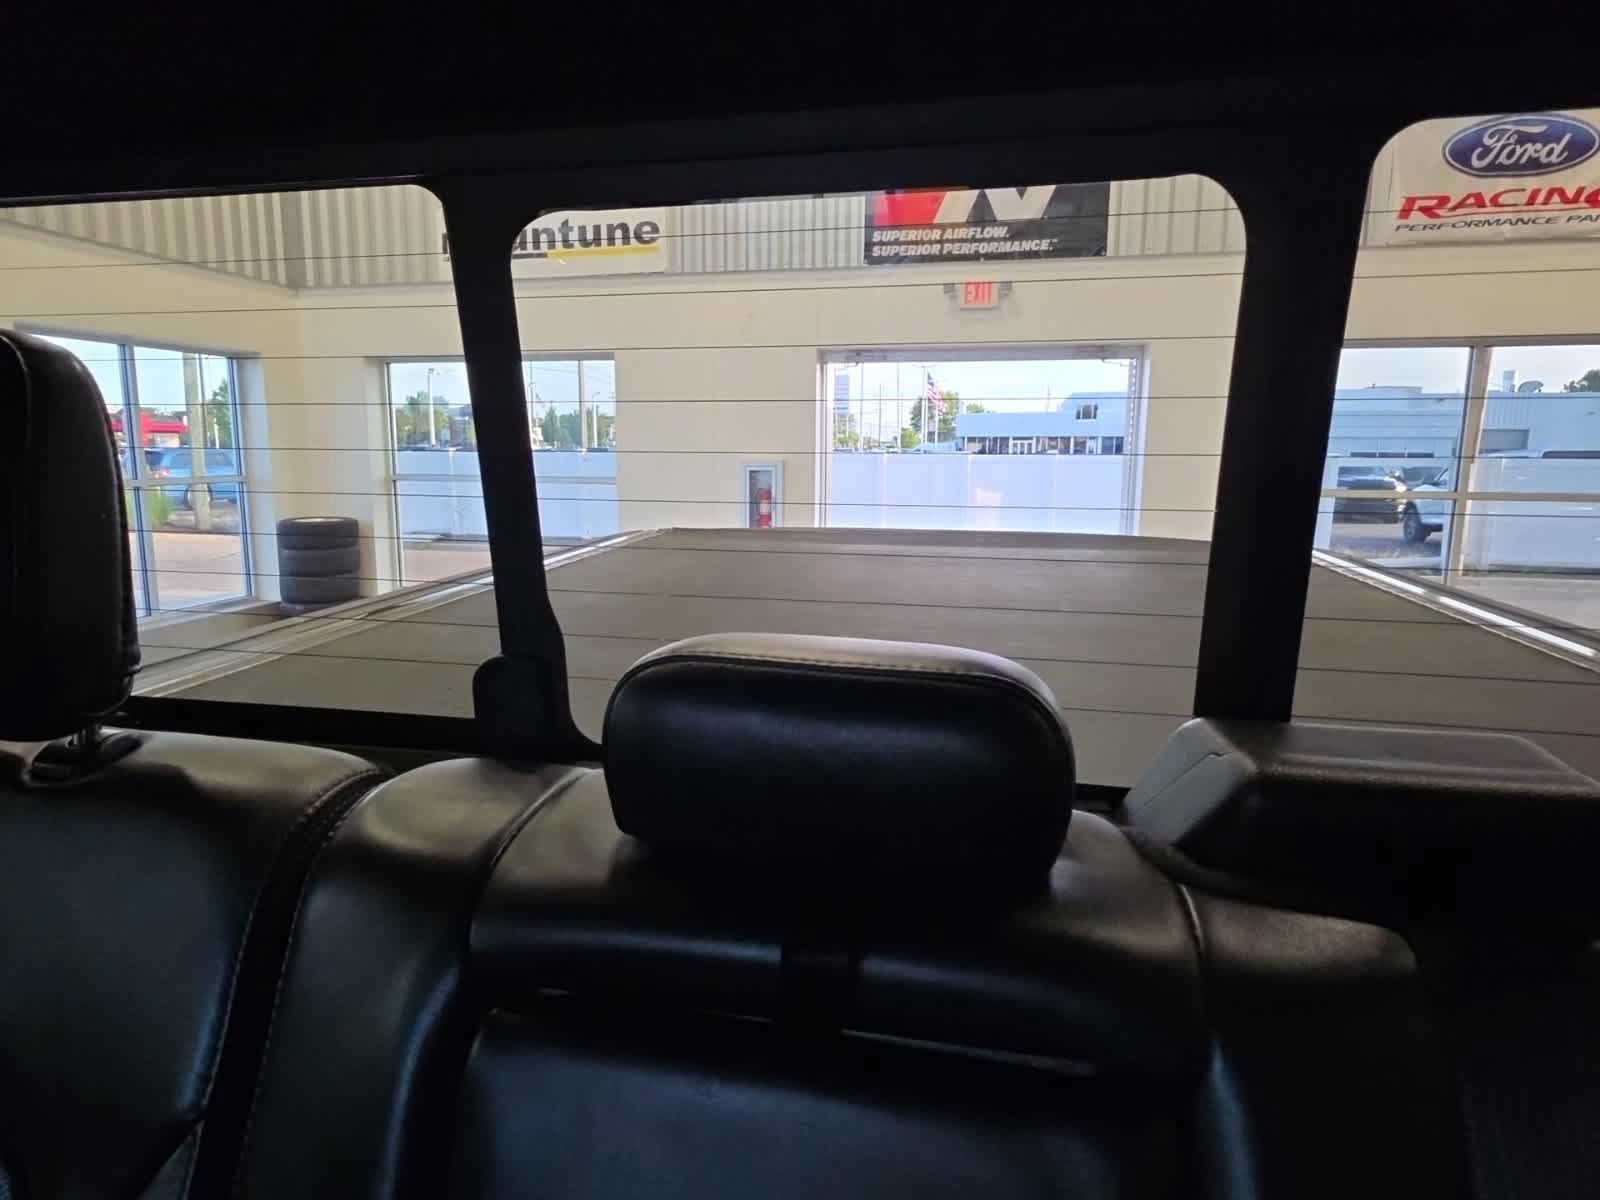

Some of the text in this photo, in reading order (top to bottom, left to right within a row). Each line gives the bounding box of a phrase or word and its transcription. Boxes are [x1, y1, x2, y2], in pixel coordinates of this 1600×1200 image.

[1471, 124, 1572, 169] Ford
[1395, 216, 1559, 232] PERFORMANCE
[872, 226, 1009, 242] SUPERIOR AIRFLOW.
[872, 244, 941, 256] SUPERIOR
[964, 282, 993, 304] EXIT
